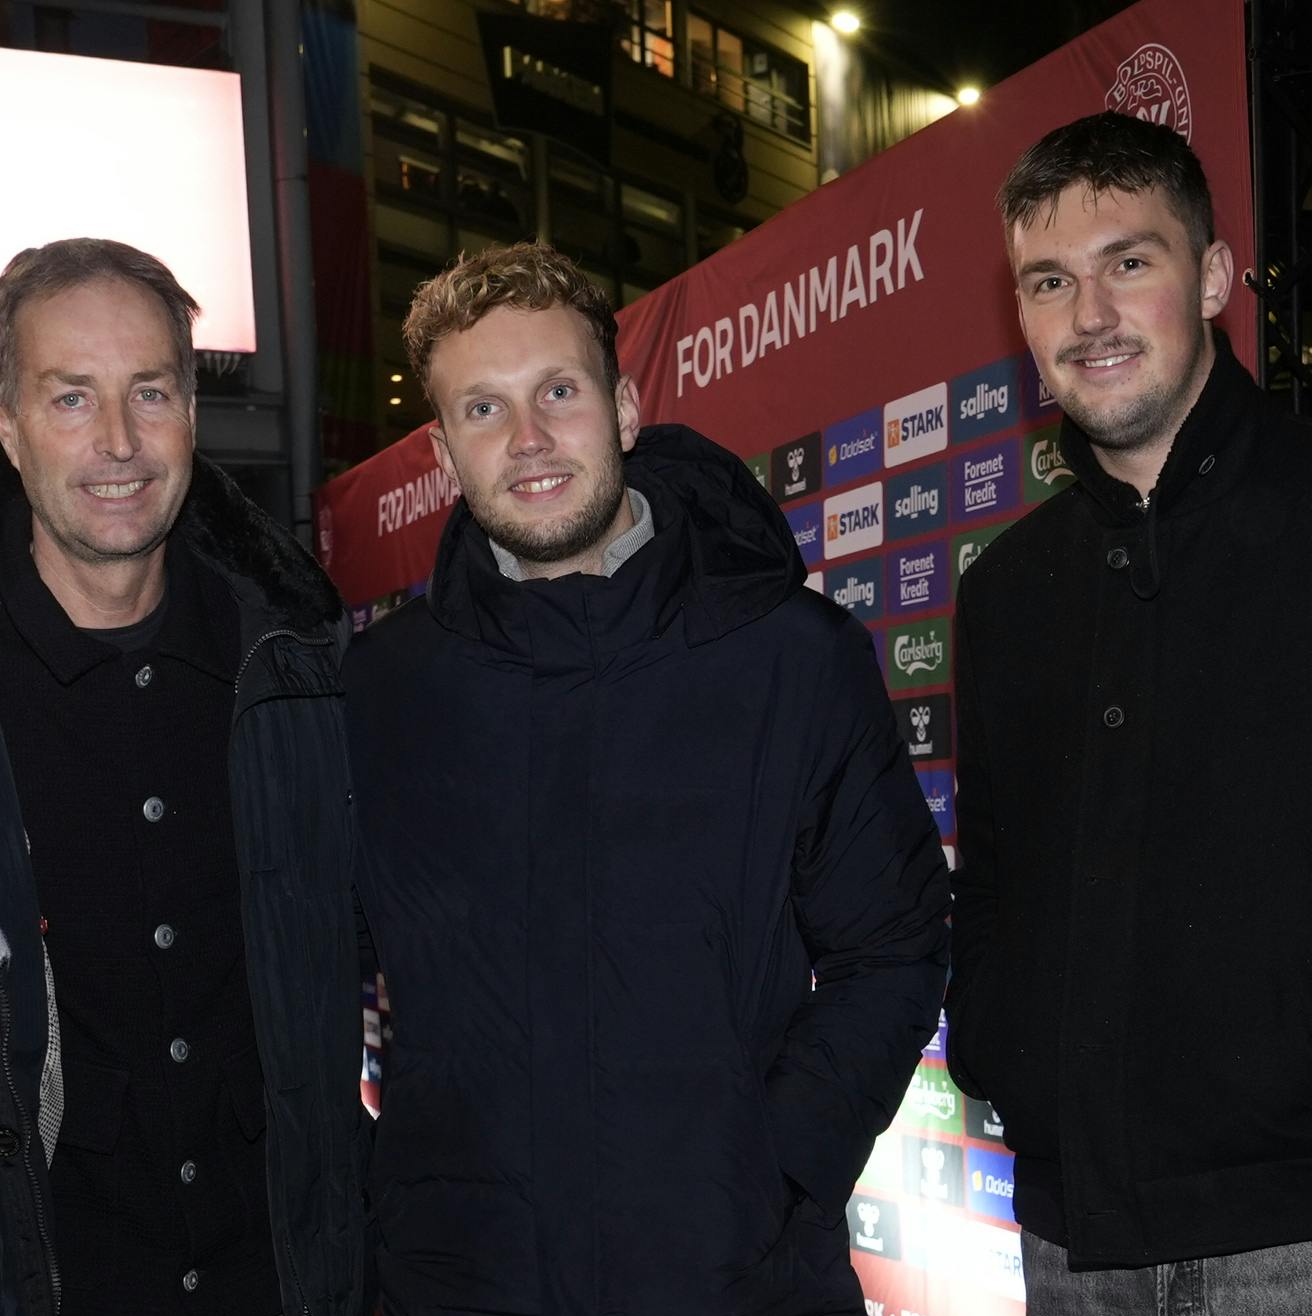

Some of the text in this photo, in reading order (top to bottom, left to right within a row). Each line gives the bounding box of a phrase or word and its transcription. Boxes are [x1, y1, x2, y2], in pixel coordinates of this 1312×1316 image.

[676, 207, 925, 398] FOR DANMARK
[960, 383, 1008, 419] salling
[900, 404, 944, 441] STARK
[839, 432, 876, 461] Oddset
[1031, 440, 1067, 481] Carls
[964, 453, 1003, 480] Forenet
[377, 487, 404, 537] FOR
[405, 467, 461, 525] DANMA
[895, 484, 938, 519] salling
[964, 483, 997, 507] Kredit
[839, 502, 880, 536] STARK
[899, 553, 935, 576] Forenet
[834, 577, 874, 608] salling
[900, 578, 929, 600] Kredit
[895, 631, 943, 674] Carlsberg
[908, 741, 933, 756] hummel
[985, 1174, 1014, 1198] Odds
